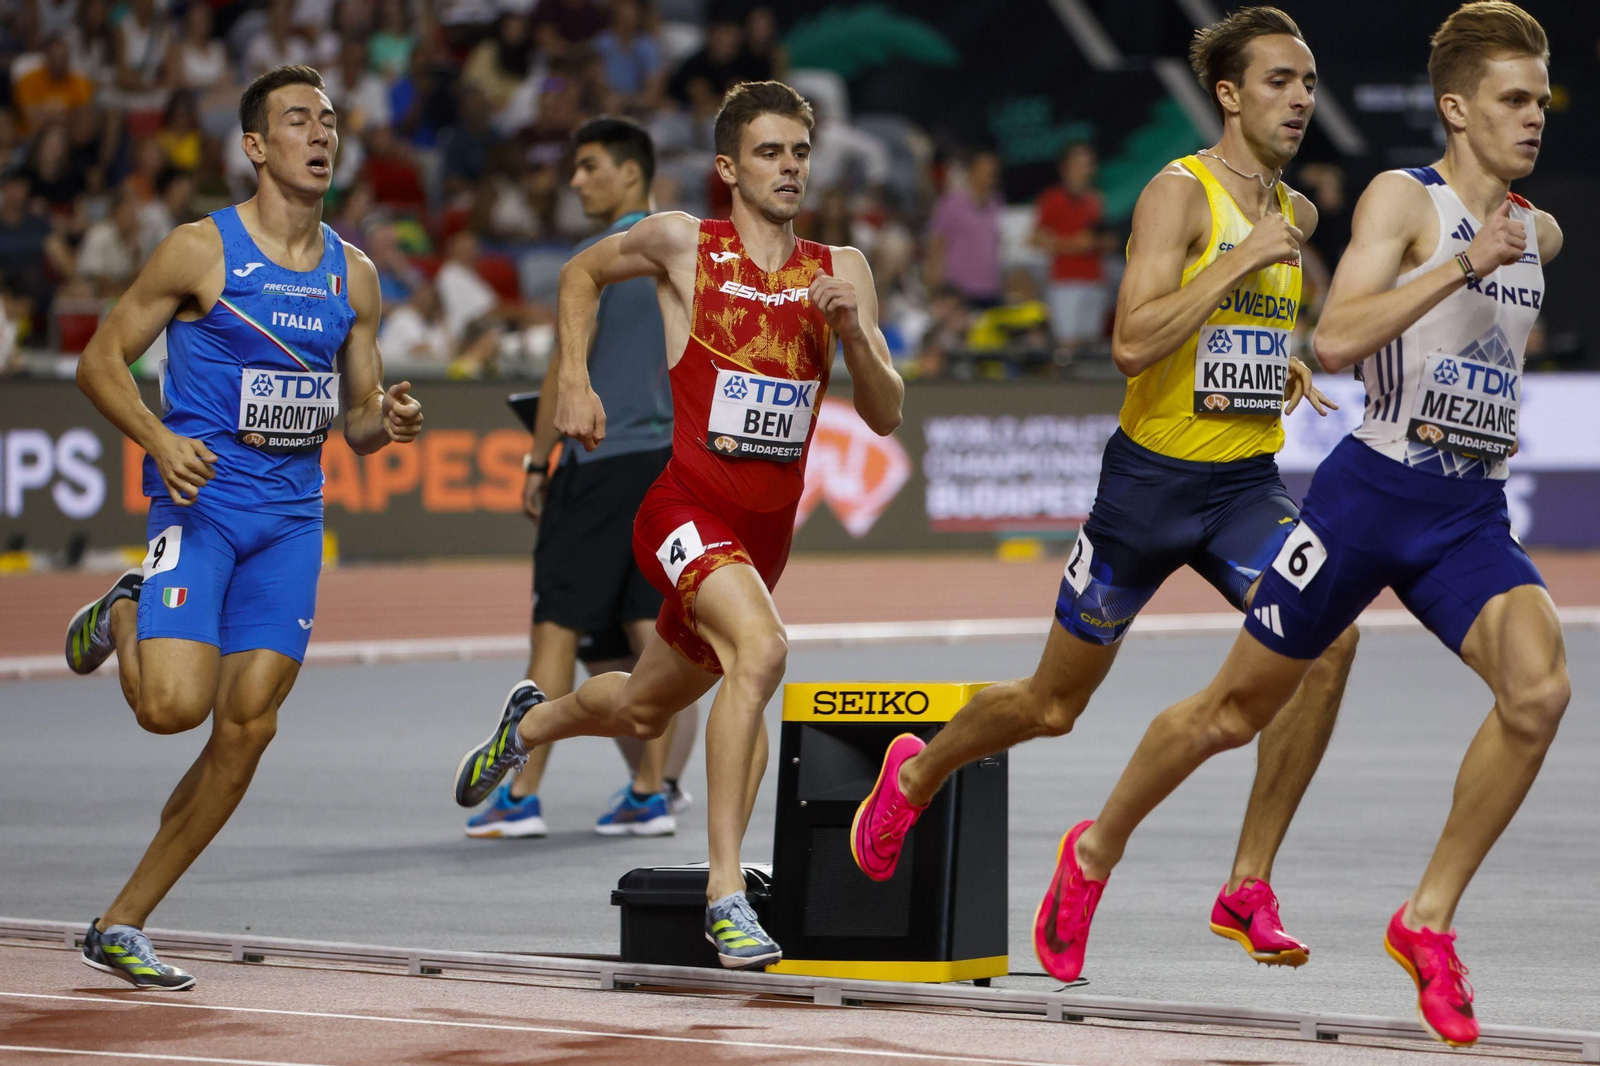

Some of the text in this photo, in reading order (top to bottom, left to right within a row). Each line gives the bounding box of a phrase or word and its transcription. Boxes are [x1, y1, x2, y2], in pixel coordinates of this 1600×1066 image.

[263, 283, 327, 297] FRECCIAROSSA
[1219, 289, 1296, 322] SWEDEN
[272, 312, 323, 332] ITALIA
[1232, 329, 1288, 358] TDK
[274, 376, 333, 399] TDK
[749, 378, 812, 408] TDK
[1461, 362, 1518, 401] TDK
[245, 403, 334, 430] BARONTINI
[743, 408, 794, 438] BEN
[1420, 390, 1516, 437] MEZIANE
[269, 437, 315, 447] BUDAPEST
[741, 442, 793, 457] BUDAPEST
[1447, 432, 1507, 455] BUDAPEST
[151, 536, 167, 569] 9
[670, 538, 686, 565] 4
[1067, 538, 1084, 579] 2
[1288, 541, 1313, 577] 6
[813, 690, 929, 715] SEIKO
